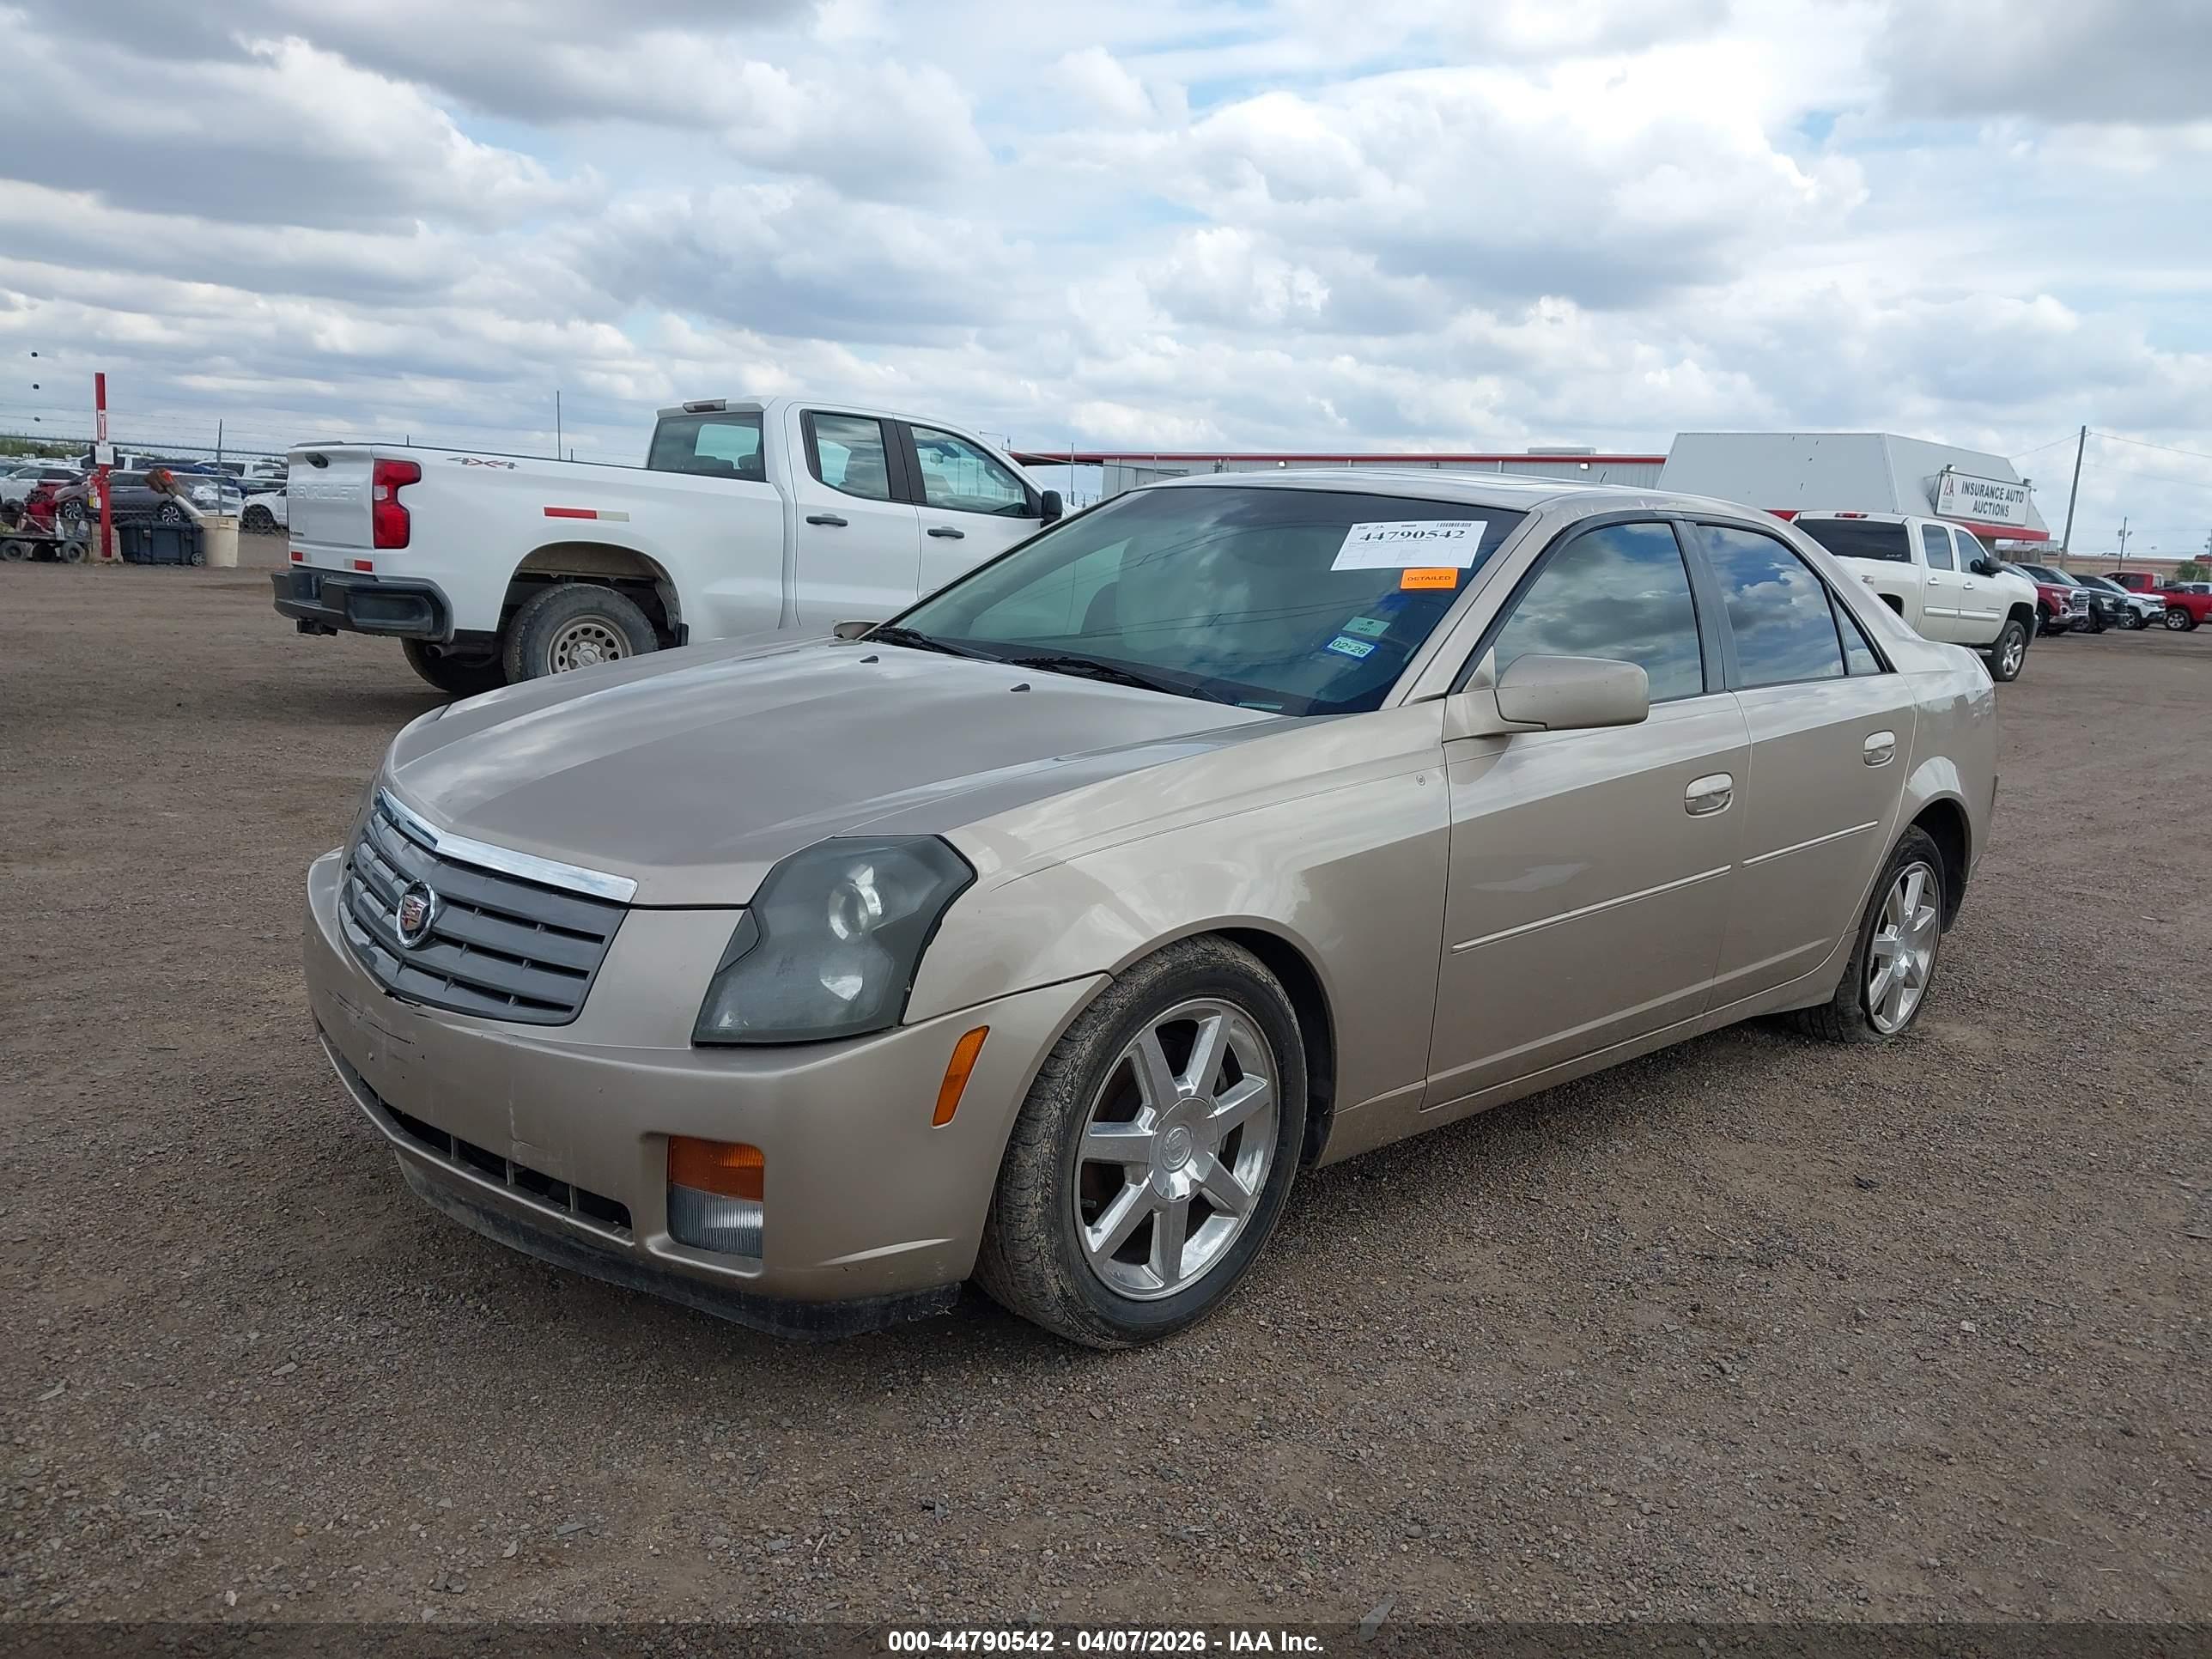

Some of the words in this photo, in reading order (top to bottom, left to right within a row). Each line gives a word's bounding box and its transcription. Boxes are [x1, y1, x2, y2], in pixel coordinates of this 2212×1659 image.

[1961, 481, 2005, 501] INSURANCE
[2004, 488, 2025, 504] AUTO
[1972, 499, 2010, 518] AUCTIONS
[1360, 530, 1466, 541] 44790542
